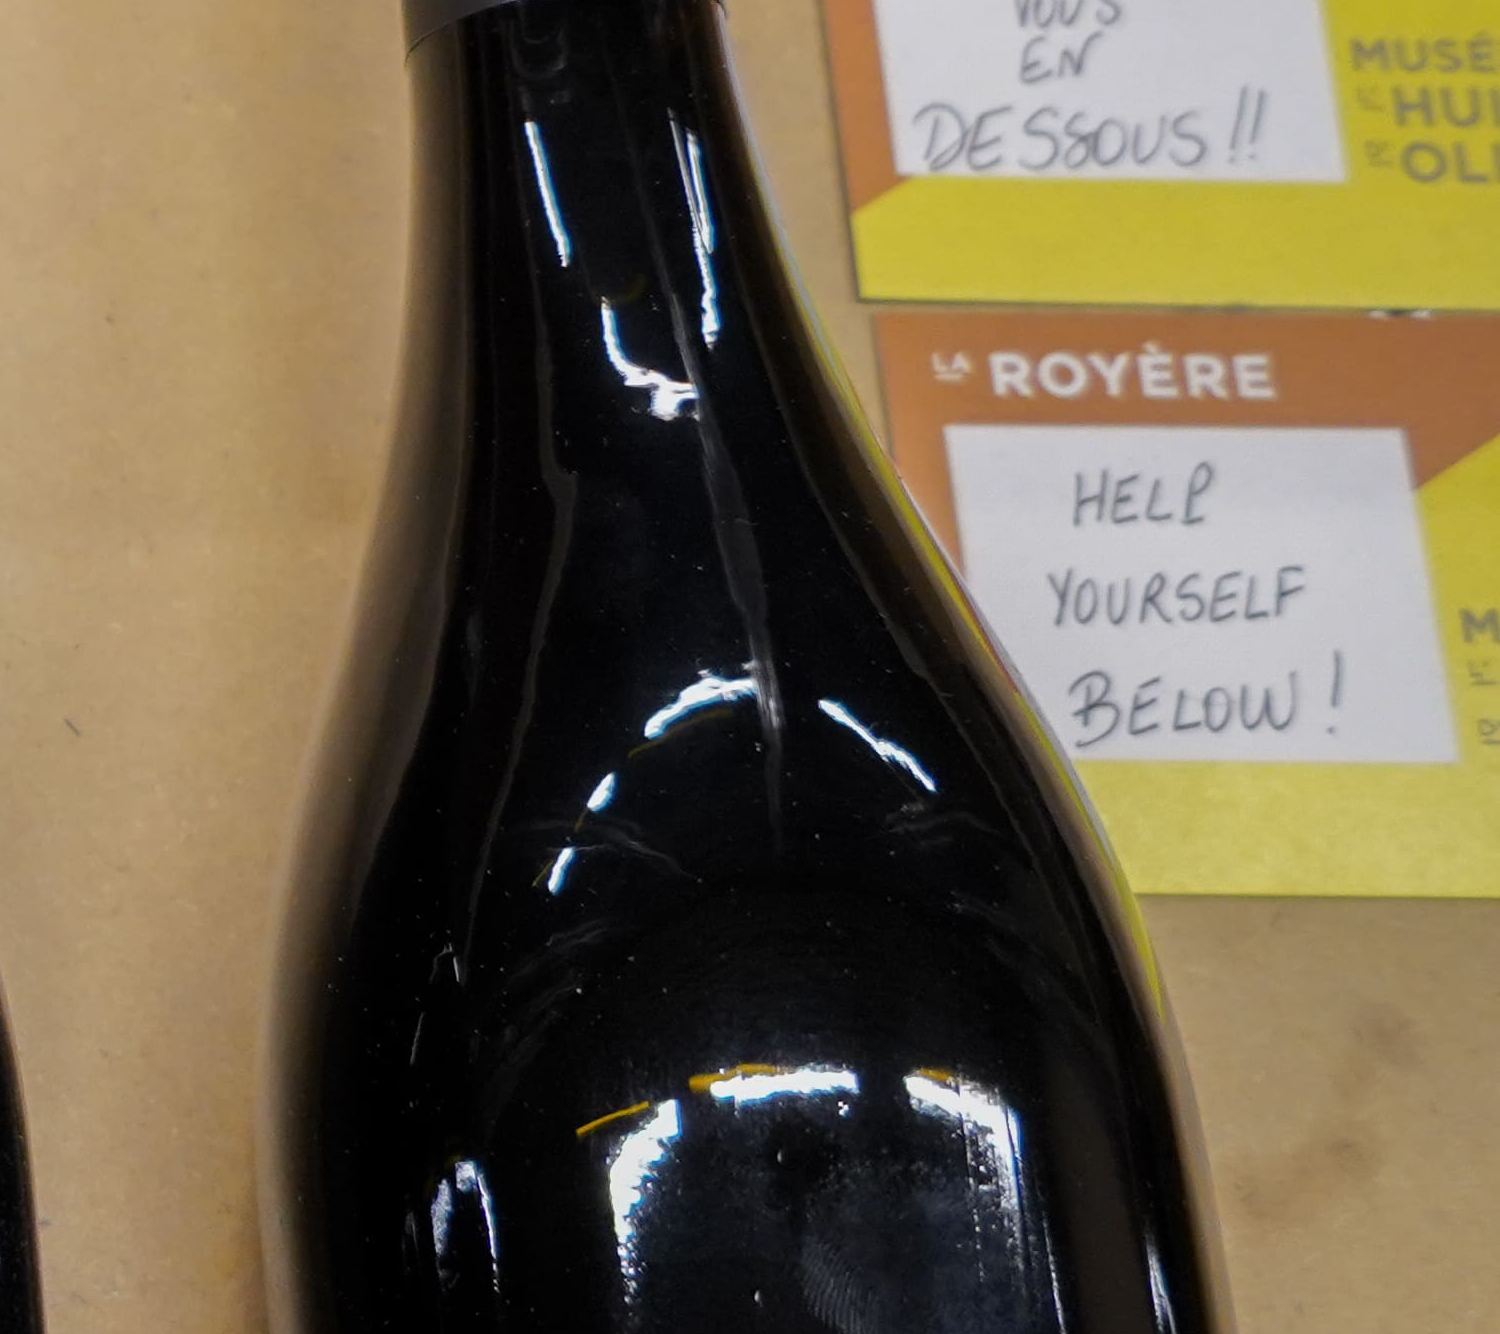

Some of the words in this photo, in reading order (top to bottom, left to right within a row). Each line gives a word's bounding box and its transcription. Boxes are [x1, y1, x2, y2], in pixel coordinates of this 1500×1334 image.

[1018, 31, 1102, 85] EN
[932, 353, 971, 381] LA
[989, 342, 1276, 398] ROYÈRE
[1073, 462, 1216, 526] HELP
[1048, 567, 1306, 626] YOURSELF
